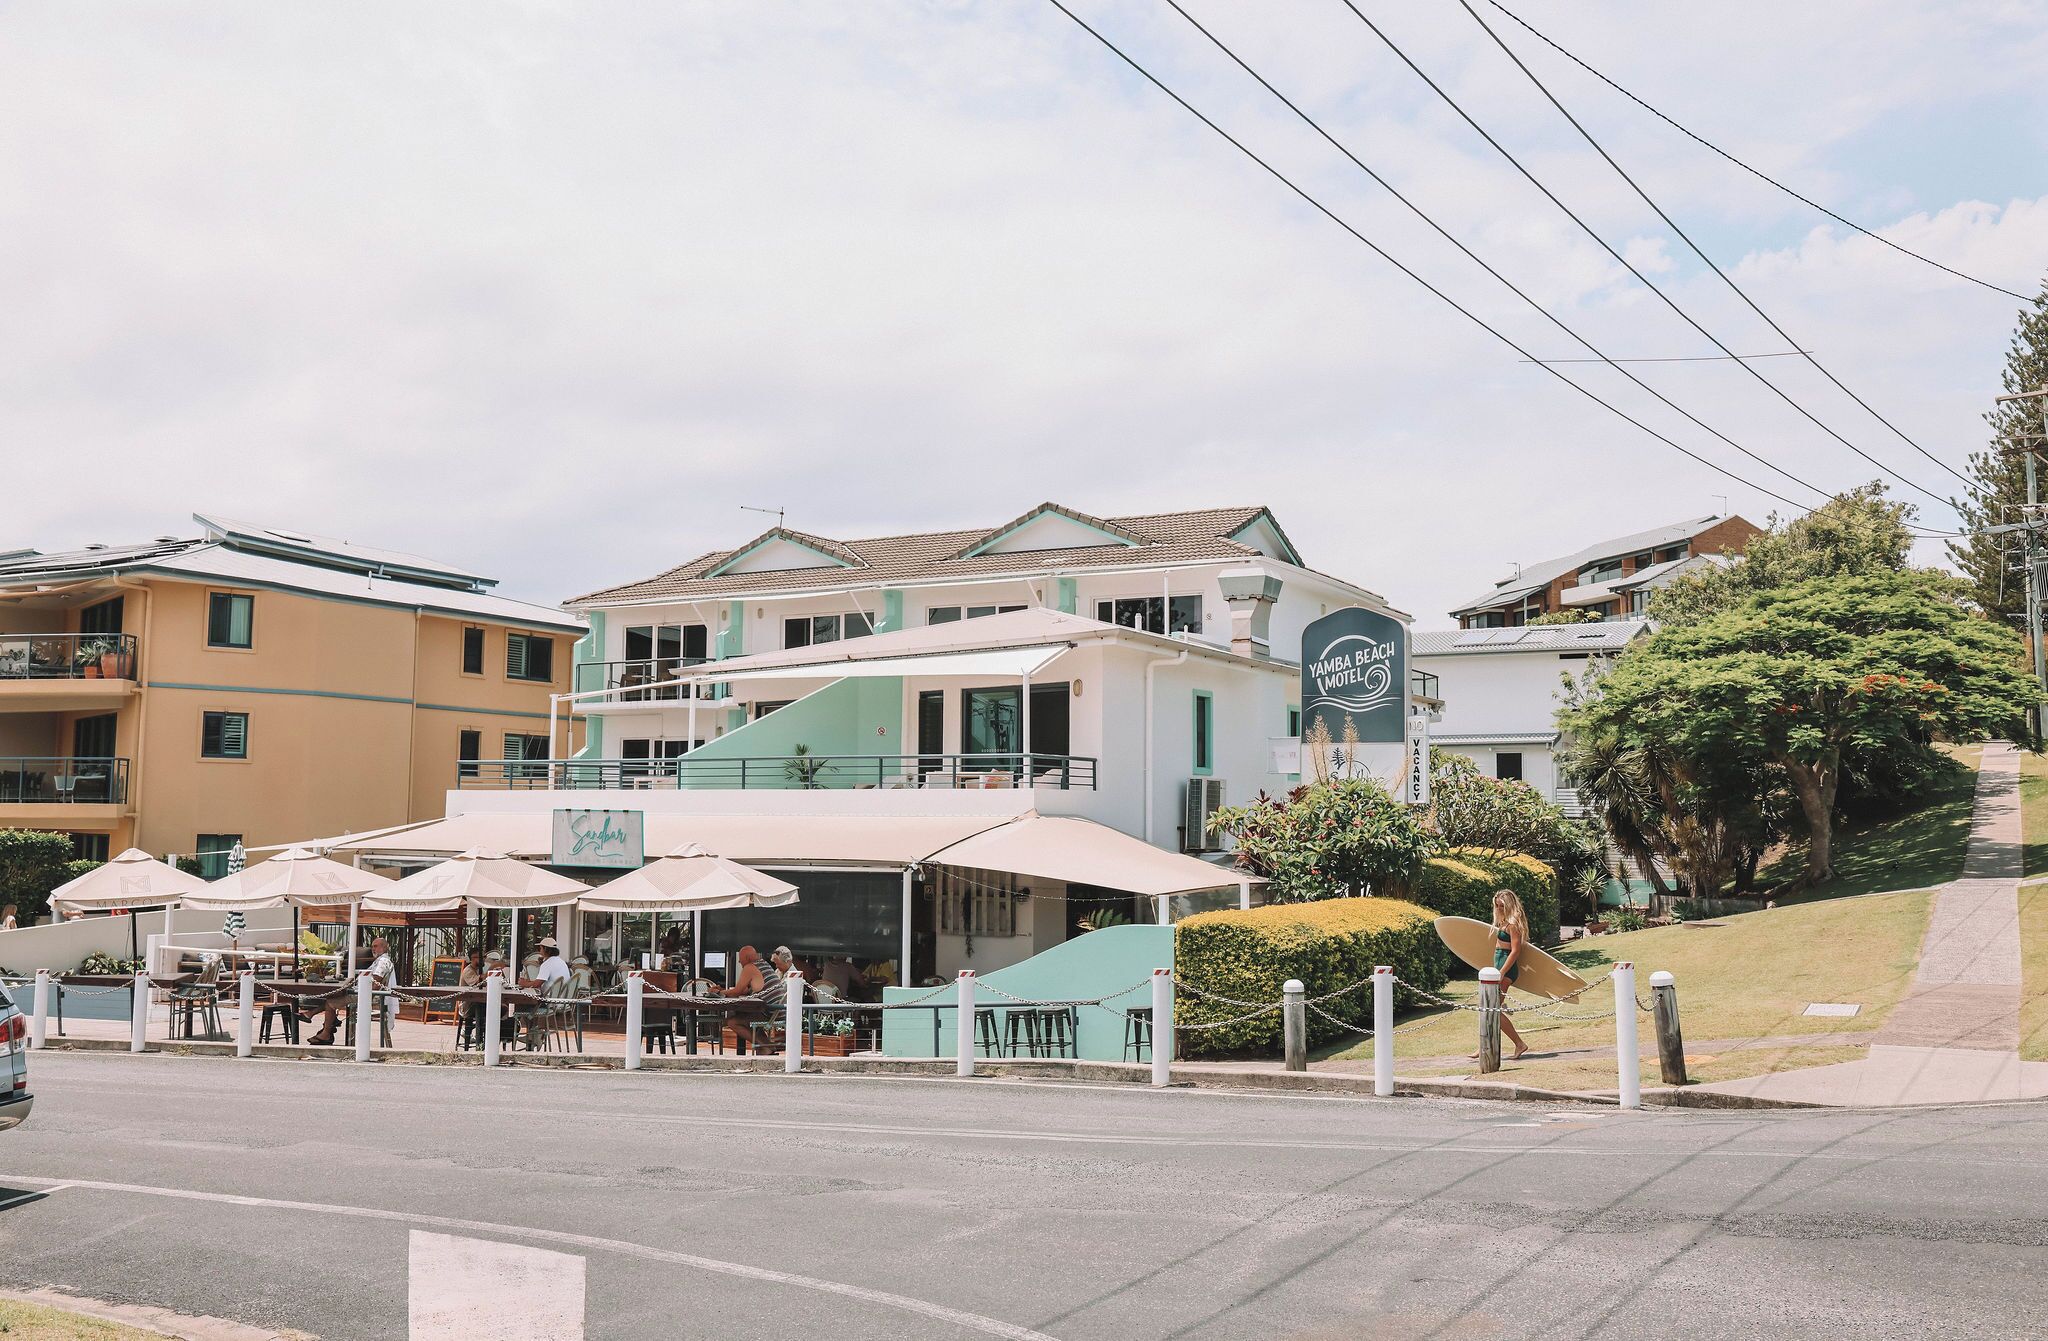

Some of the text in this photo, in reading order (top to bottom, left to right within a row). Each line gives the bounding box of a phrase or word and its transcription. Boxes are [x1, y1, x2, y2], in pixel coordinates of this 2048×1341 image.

[1309, 641, 1395, 678] YAMBA BEACH
[1325, 667, 1365, 690] MOTEL
[1409, 721, 1424, 732] NO
[1413, 739, 1421, 801] VACANCY
[571, 814, 627, 852] Sandbar
[96, 898, 152, 908] MARCO
[314, 895, 357, 904] MARCO
[495, 898, 540, 908] MARCO
[622, 900, 684, 911] MARCO
